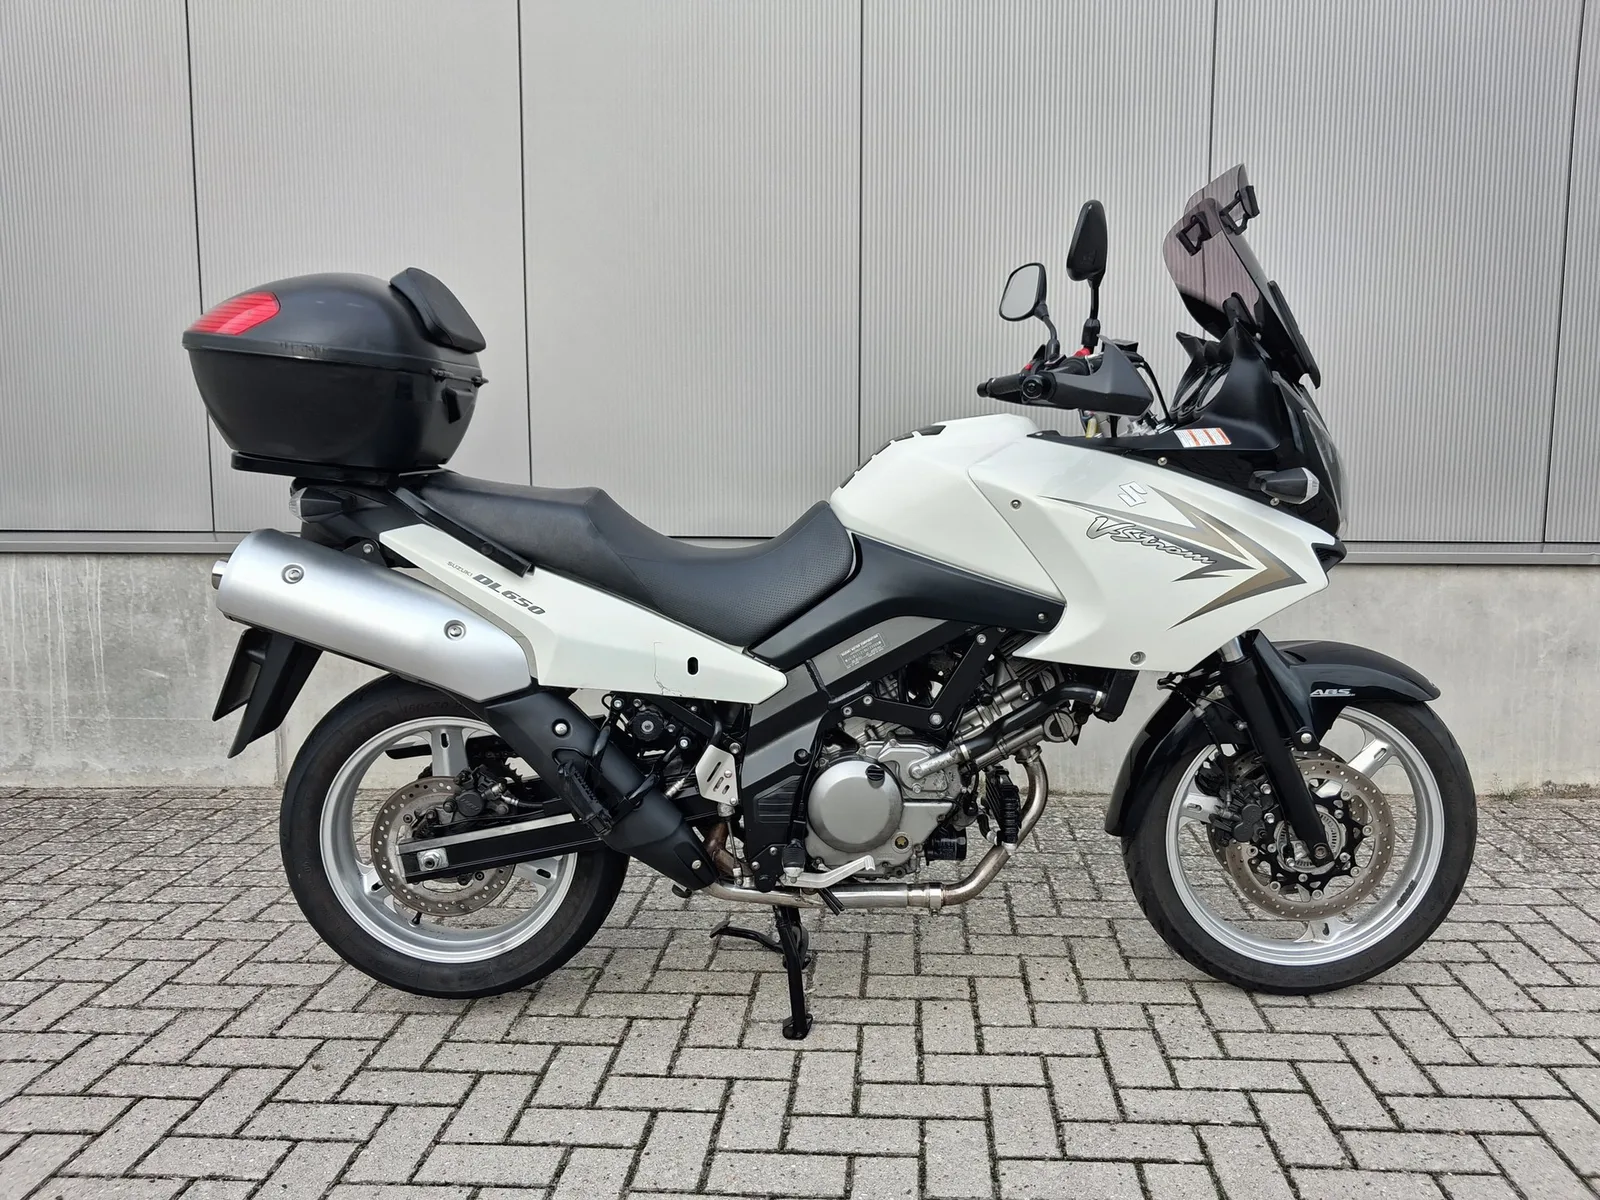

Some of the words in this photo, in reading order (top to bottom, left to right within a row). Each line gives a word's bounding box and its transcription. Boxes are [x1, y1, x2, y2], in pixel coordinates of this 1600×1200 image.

[447, 561, 473, 577] SUZUKI
[472, 573, 546, 615] DL650
[1310, 688, 1351, 697] ABS
